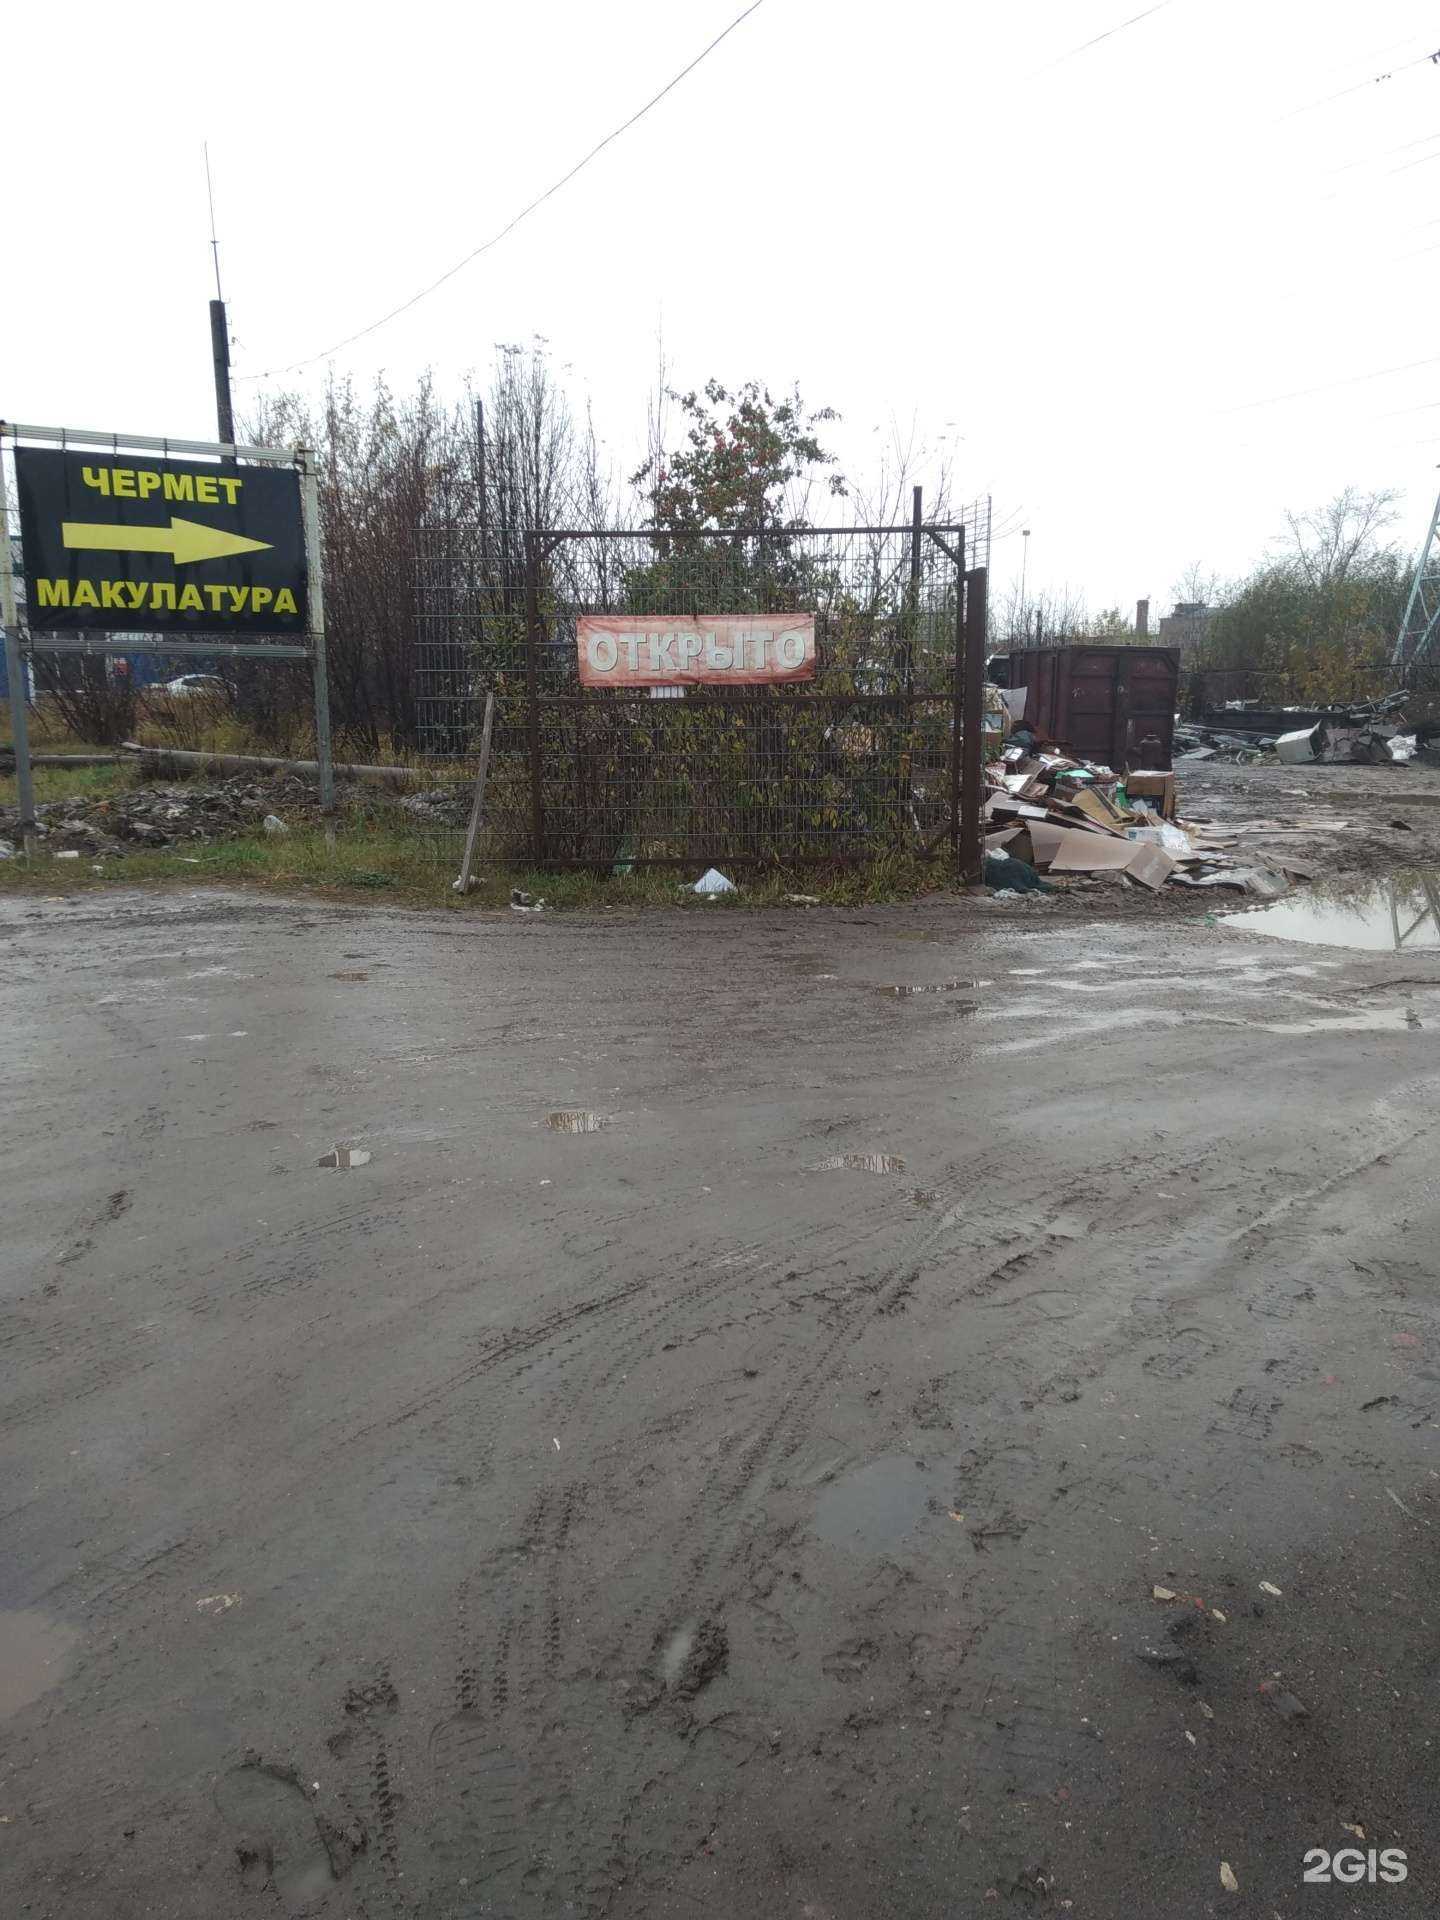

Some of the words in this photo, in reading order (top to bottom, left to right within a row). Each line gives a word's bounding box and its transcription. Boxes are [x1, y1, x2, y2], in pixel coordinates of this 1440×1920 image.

[81, 467, 242, 505] ЧЕРМЕТ
[36, 578, 298, 614] МАКУЛАТУРА
[587, 631, 806, 672] ОТКРЫТО
